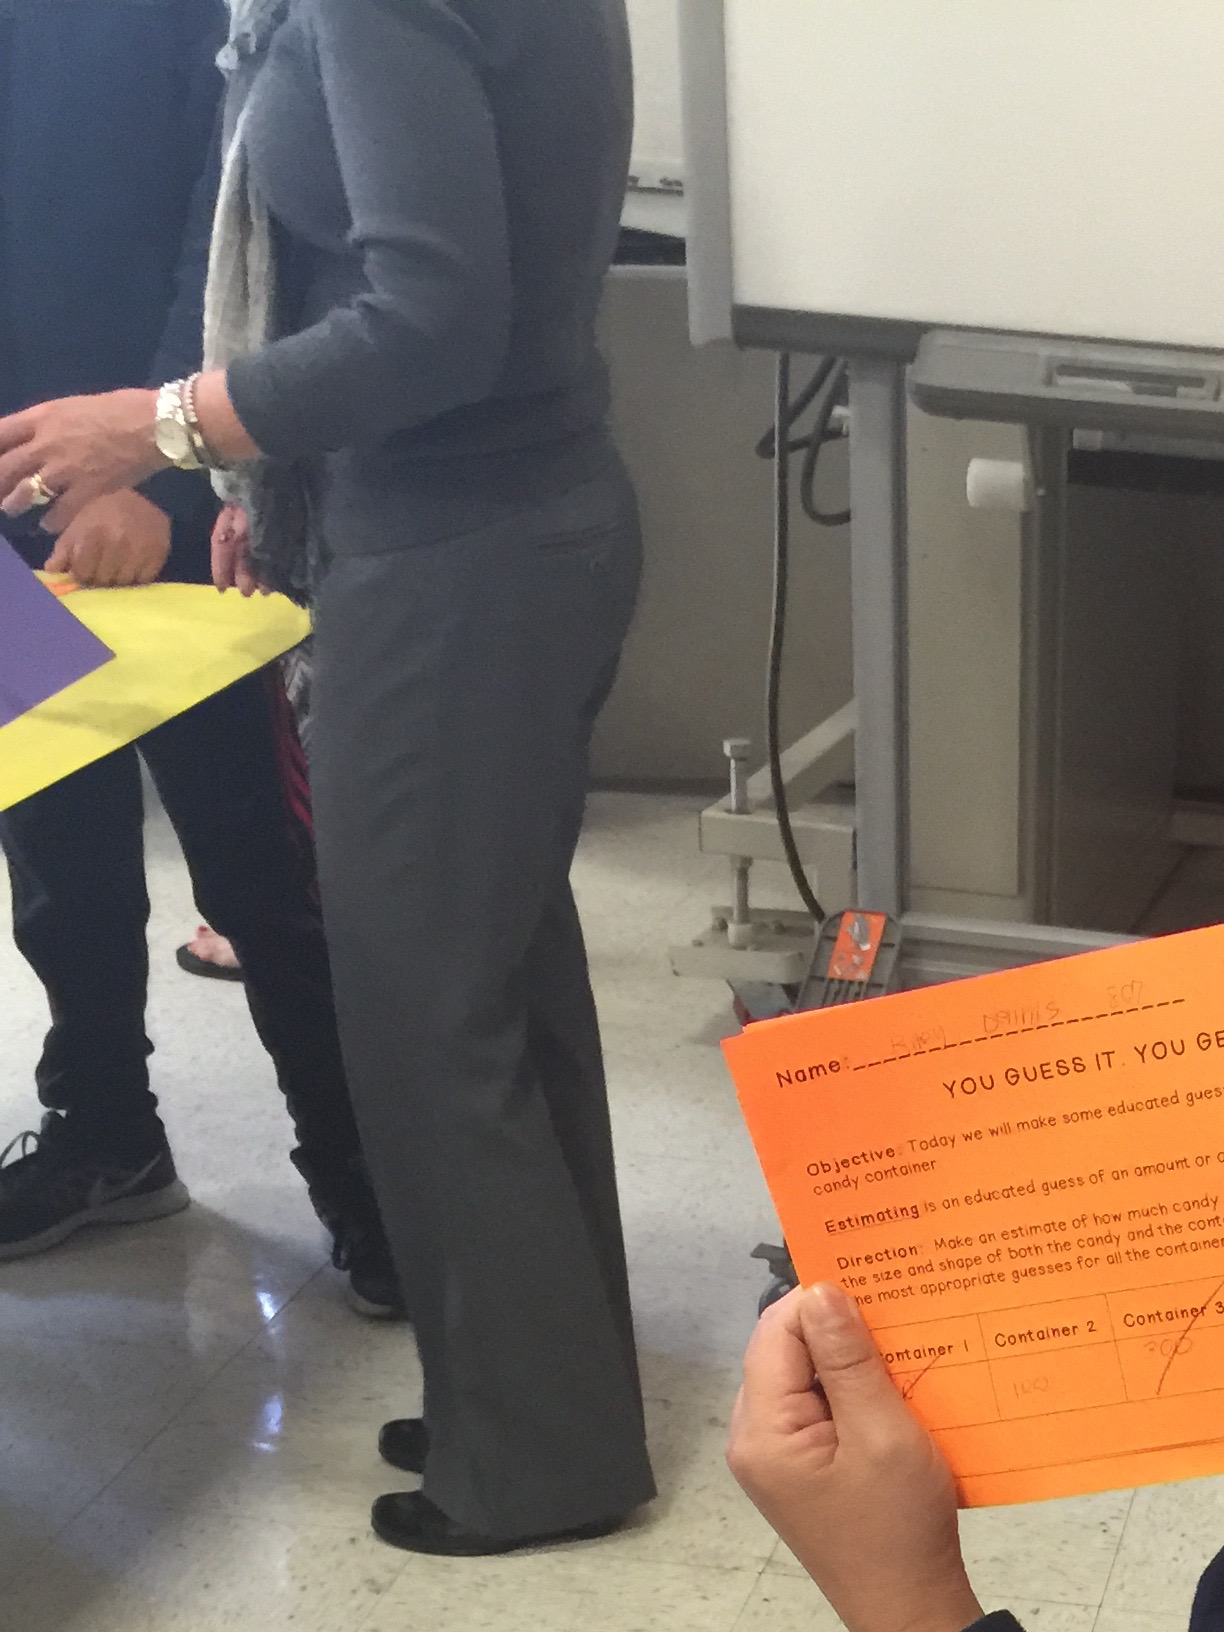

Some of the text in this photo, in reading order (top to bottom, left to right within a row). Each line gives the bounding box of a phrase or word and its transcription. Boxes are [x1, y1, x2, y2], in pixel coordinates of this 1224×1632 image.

[943, 1075, 994, 1098] YOU
[1005, 1057, 1086, 1086] GUESS
[1134, 1039, 1185, 1063] YOU
[907, 1135, 955, 1152] Today
[962, 1130, 983, 1141] we
[988, 1122, 1011, 1137] will
[1017, 1116, 1056, 1132] make
[1063, 1109, 1102, 1124] some
[1108, 1090, 1180, 1116] educated
[813, 1160, 936, 1195] candy container
[825, 1205, 920, 1234] Estimating
[924, 1202, 937, 1212] is
[942, 1198, 960, 1209] an
[964, 1179, 1036, 1205] educated
[1042, 1177, 1085, 1196] guess
[1089, 1169, 1104, 1184] of
[1111, 1169, 1128, 1181] an
[1134, 1157, 1190, 1177] amount
[1195, 1155, 1210, 1167] or
[934, 1236, 972, 1250] Make
[979, 1233, 996, 1244] an
[1001, 1221, 1066, 1240] estimate
[1072, 1214, 1088, 1229] of
[1093, 1213, 1121, 1225] how
[1128, 1203, 1168, 1221] much
[1173, 1194, 1218, 1212] candy
[840, 1276, 866, 1290] the
[873, 1269, 902, 1283] size
[908, 1259, 934, 1276] and
[939, 1256, 982, 1271] shape
[987, 1249, 1001, 1263] of
[1008, 1244, 1043, 1259] both
[1047, 1240, 1071, 1252] the
[1077, 1230, 1120, 1249] candy
[1127, 1224, 1154, 1241] and
[1157, 1223, 1182, 1235] the
[854, 1295, 872, 1307] he
[878, 1285, 915, 1302] most
[920, 1272, 1005, 1296] appropriate
[1012, 1262, 1072, 1283] guesses
[1077, 1256, 1100, 1269] for
[1107, 1252, 1122, 1265] all
[1125, 1249, 1150, 1261] the
[994, 1320, 1097, 1347] Container 2
[1123, 1303, 1207, 1327] Container
[880, 1344, 954, 1364] ontainer
